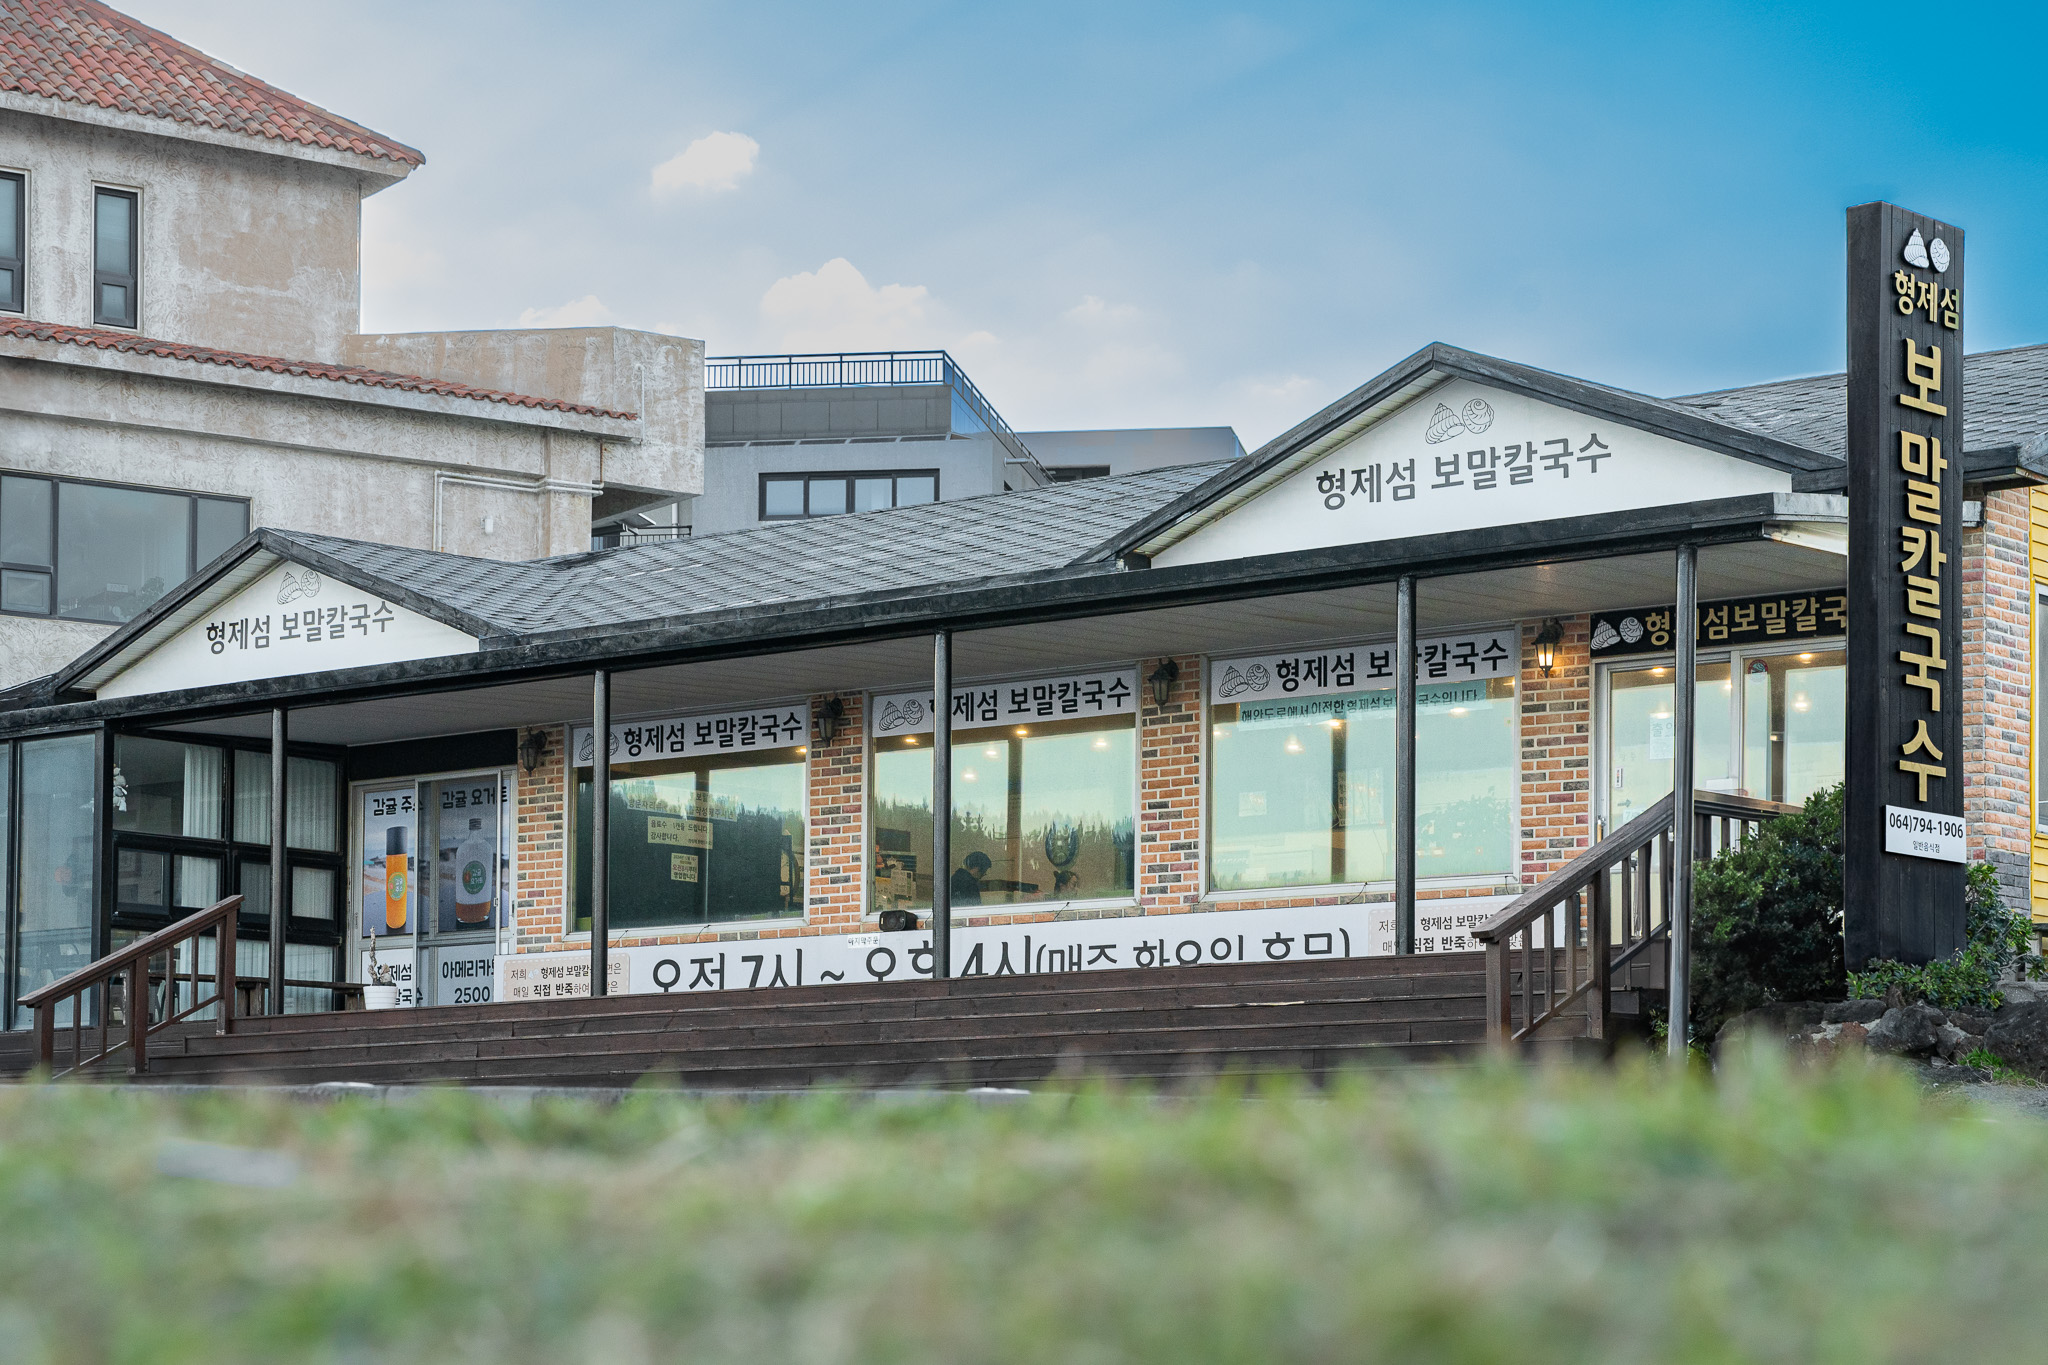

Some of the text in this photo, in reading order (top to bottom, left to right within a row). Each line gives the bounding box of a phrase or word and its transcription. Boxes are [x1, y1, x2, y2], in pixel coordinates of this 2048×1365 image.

[1895, 269, 1960, 330] 형제섬
[1316, 432, 1612, 511] 형제섬 보말칼국수
[1899, 337, 1948, 802] 보말칼국수
[206, 601, 395, 655] 형제섬 보말칼국수
[1645, 596, 1847, 647] 형섬보말칼국
[1276, 638, 1509, 692] 형제섬 보칼국수
[928, 677, 1131, 722] 제섬 보말칼국수
[623, 712, 803, 757] 형제섬 보말칼국수
[372, 797, 397, 816] 감귤
[442, 790, 467, 809] 감귤
[1889, 812, 1964, 839] 064)794-1906
[1912, 840, 1941, 854] 일반음식점
[1420, 915, 1452, 932] 형제섬
[1455, 913, 1494, 929] 보말칼
[1383, 940, 1397, 954] 매
[442, 958, 495, 980] 아메리카
[510, 968, 527, 981] 저희
[540, 966, 564, 980] 형제섬
[565, 964, 592, 977] 보말칼
[454, 986, 490, 1004] 2500
[513, 986, 529, 998] 매일
[533, 983, 551, 997] 직접
[555, 982, 590, 996] 반죽하여
